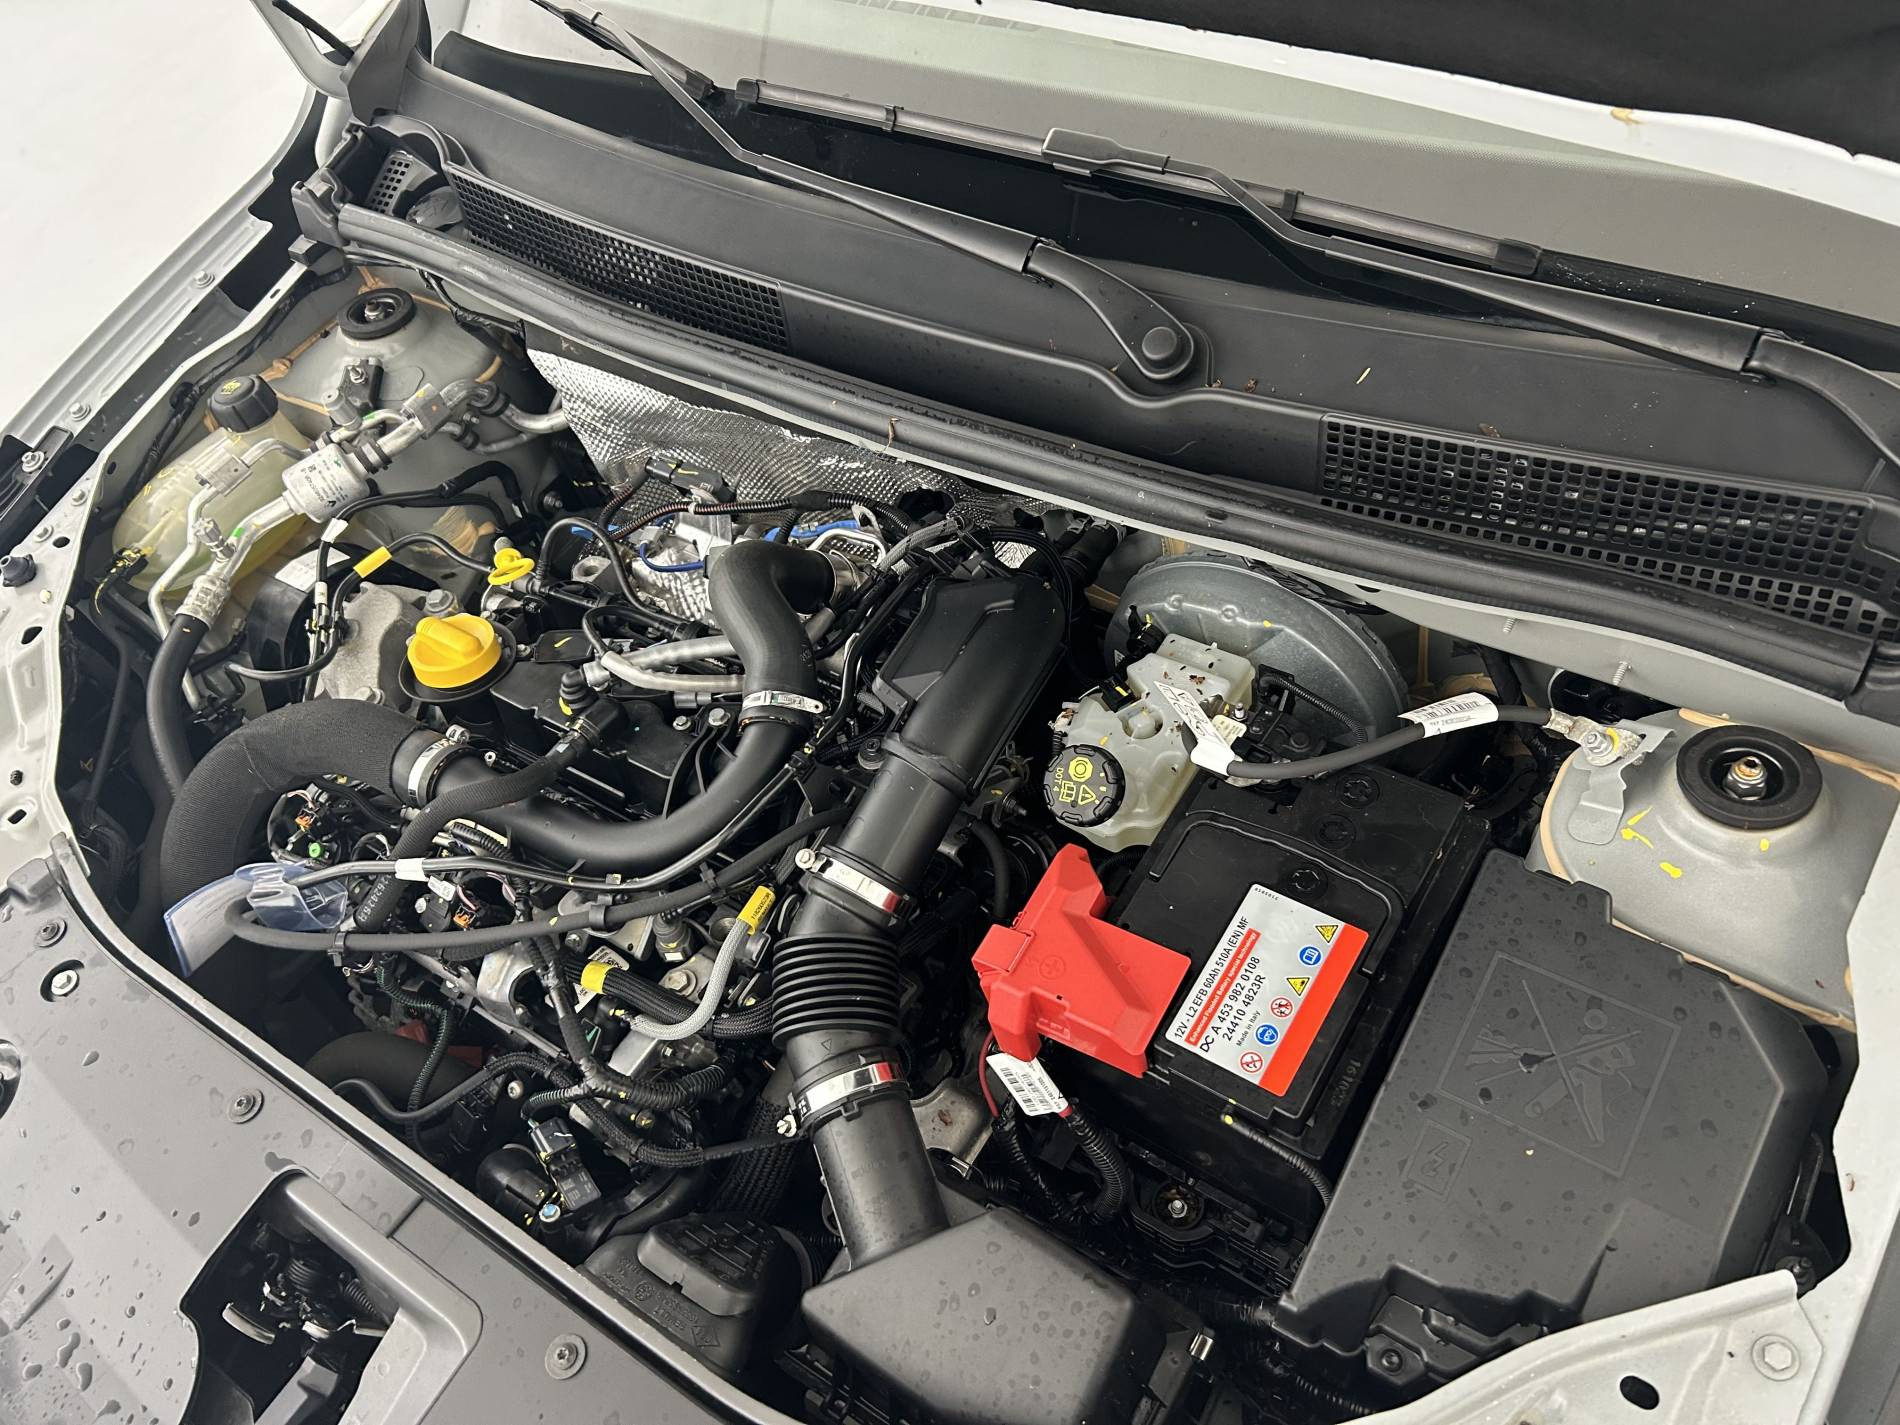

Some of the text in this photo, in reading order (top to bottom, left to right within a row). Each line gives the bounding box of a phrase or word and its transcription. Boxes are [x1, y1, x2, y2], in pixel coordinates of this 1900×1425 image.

[1055, 768, 1064, 784] DOT
[1174, 1022, 1188, 1039] 12V
[1185, 1005, 1197, 1018] L2
[1192, 987, 1208, 1006] EFB
[1202, 966, 1220, 988] 60Ah
[1215, 946, 1232, 967] 510A
[1227, 929, 1243, 948] (EN)
[1237, 916, 1249, 930] MF
[1199, 955, 1260, 1052] DC A 453 982 0108
[1221, 973, 1265, 1041] 24410 4823R
[1236, 1029, 1248, 1046] Made
[1249, 1009, 1260, 1024] Italy
